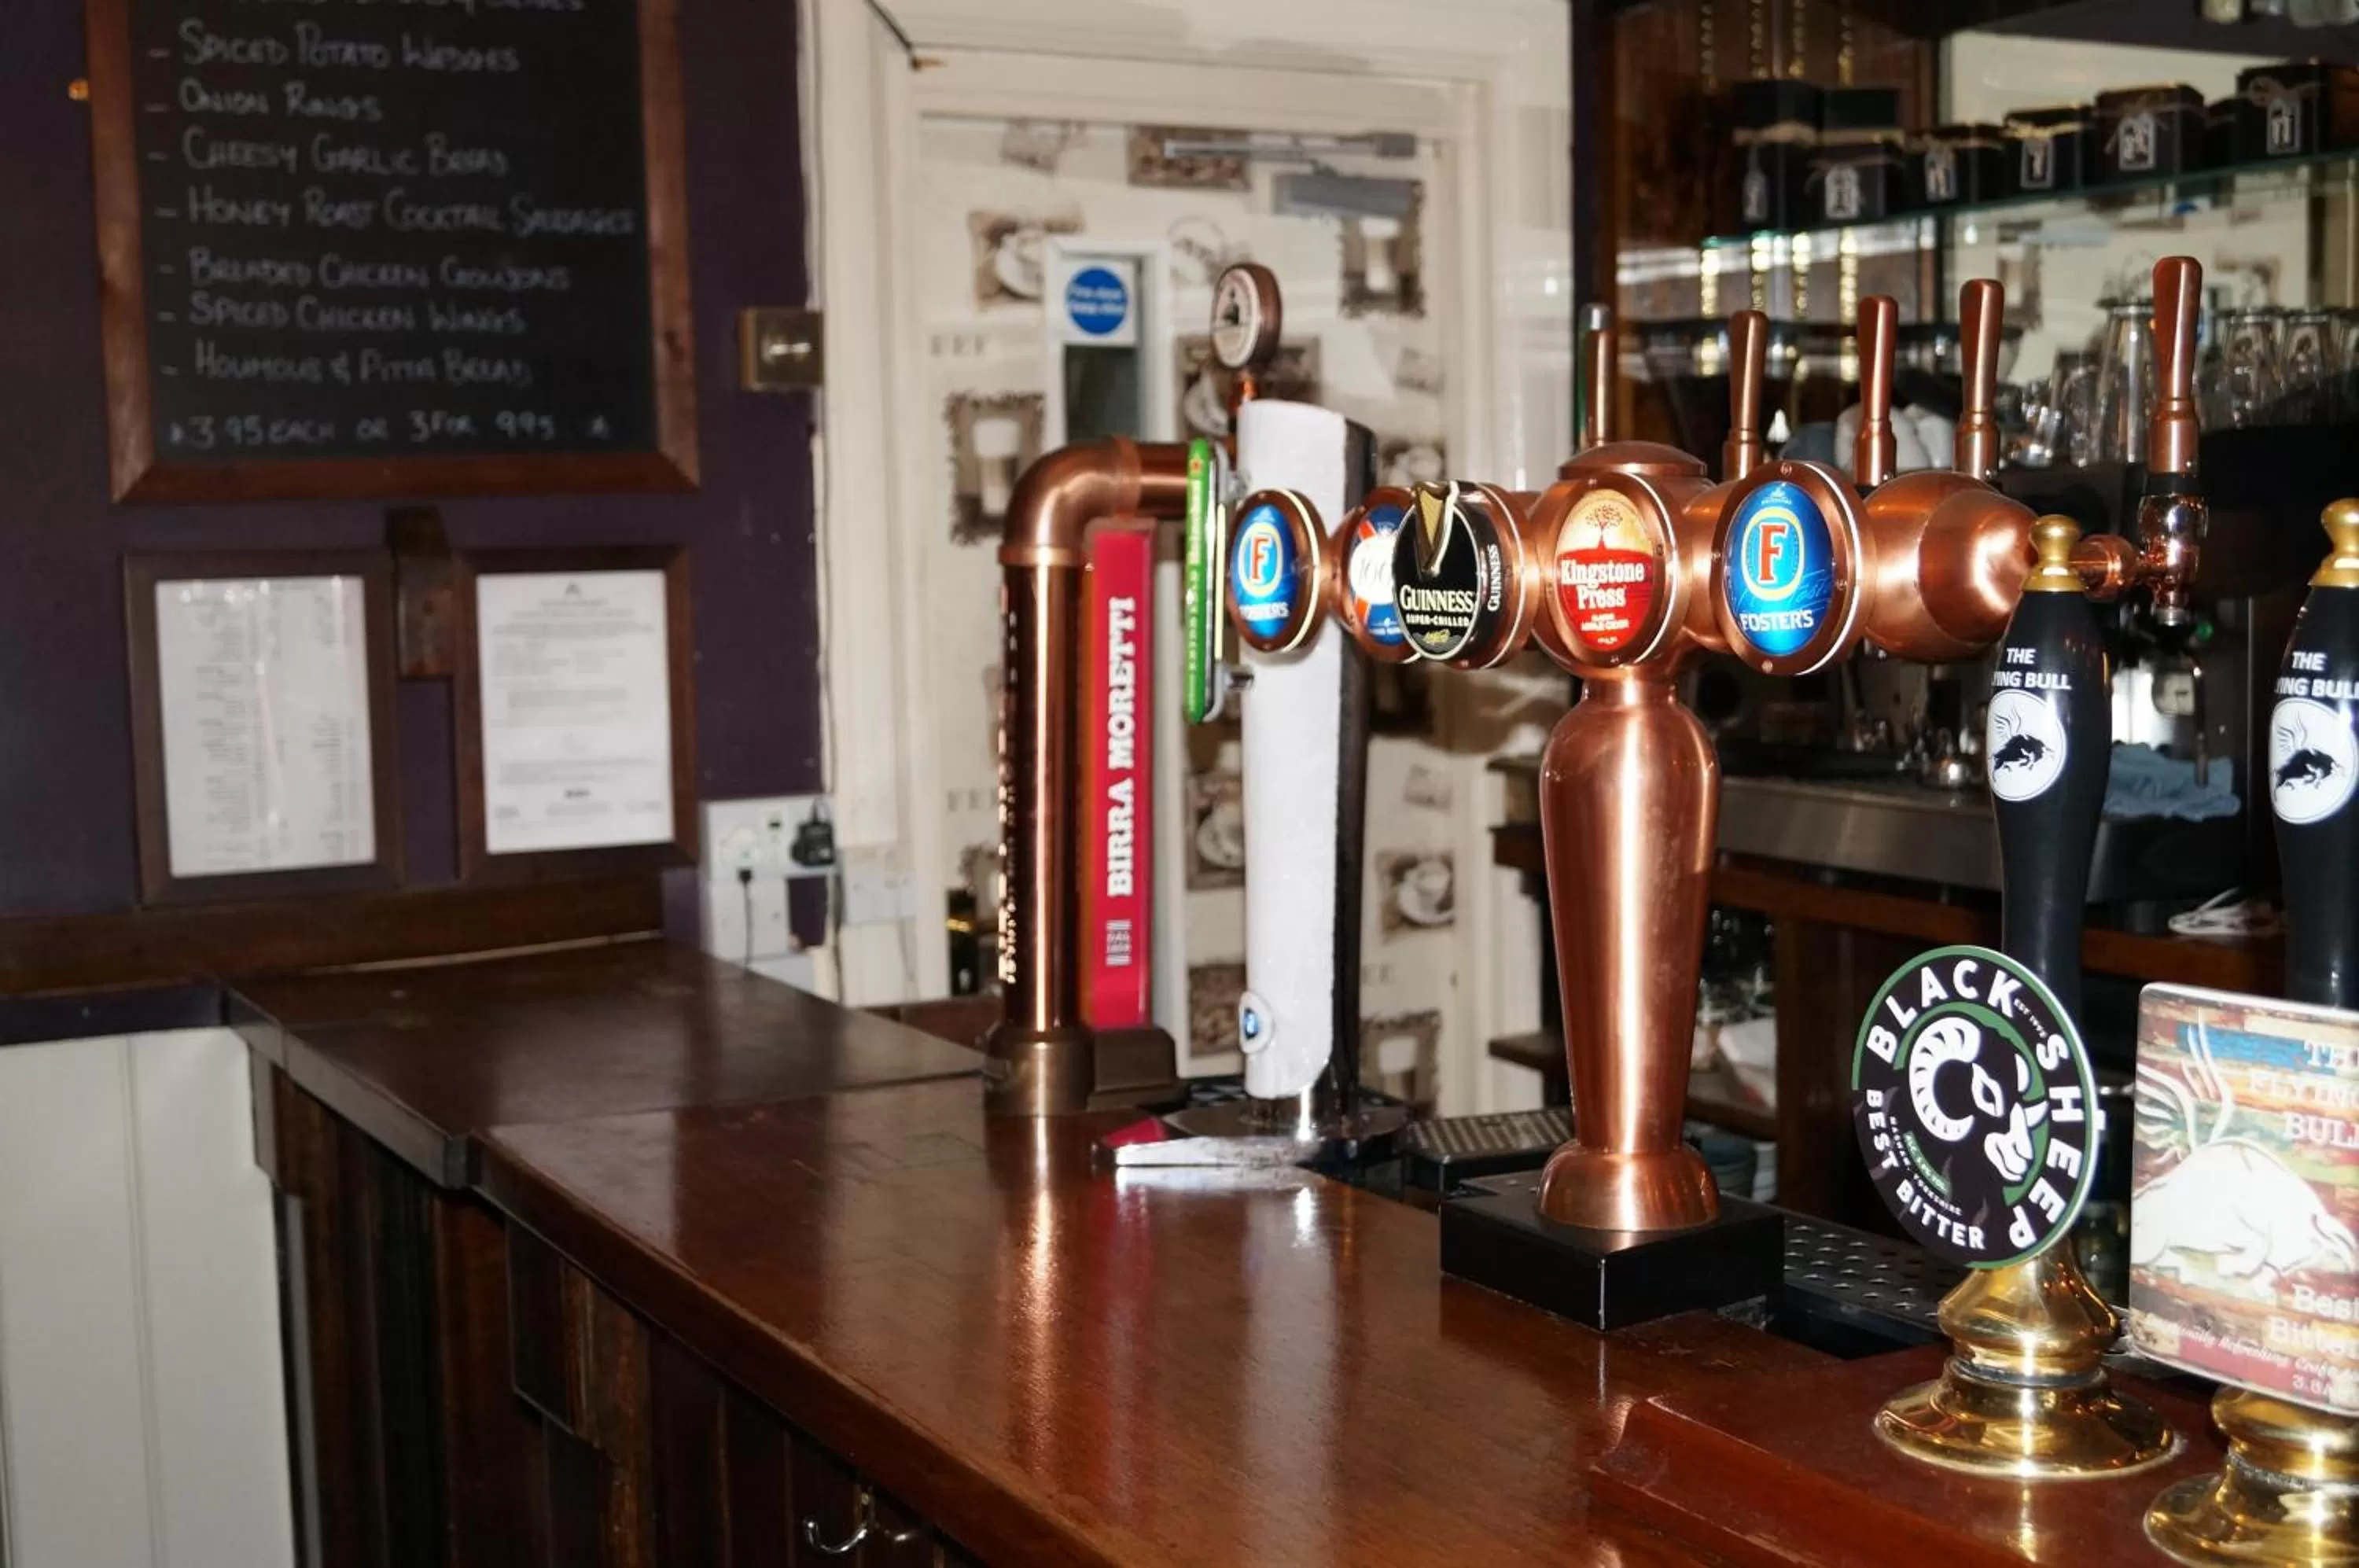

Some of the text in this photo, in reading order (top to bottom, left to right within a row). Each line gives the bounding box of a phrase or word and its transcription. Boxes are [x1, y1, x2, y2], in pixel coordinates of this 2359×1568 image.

[1757, 522, 1788, 583] F
[1487, 543, 1501, 611] GUINNESS
[1561, 559, 1645, 589] Kingstone
[1400, 584, 1475, 613] GUINNESS
[1576, 584, 1627, 610] Press
[1739, 609, 1814, 632] FOSTER'S
[2006, 647, 2037, 664] THE
[2292, 650, 2327, 671] THE
[2024, 672, 2072, 690] BULL
[1107, 596, 1135, 896] BIRRA MORETTI
[1866, 959, 2085, 1249] BLACK SHEEP
[1866, 1089, 1986, 1250] BEST BITTER
